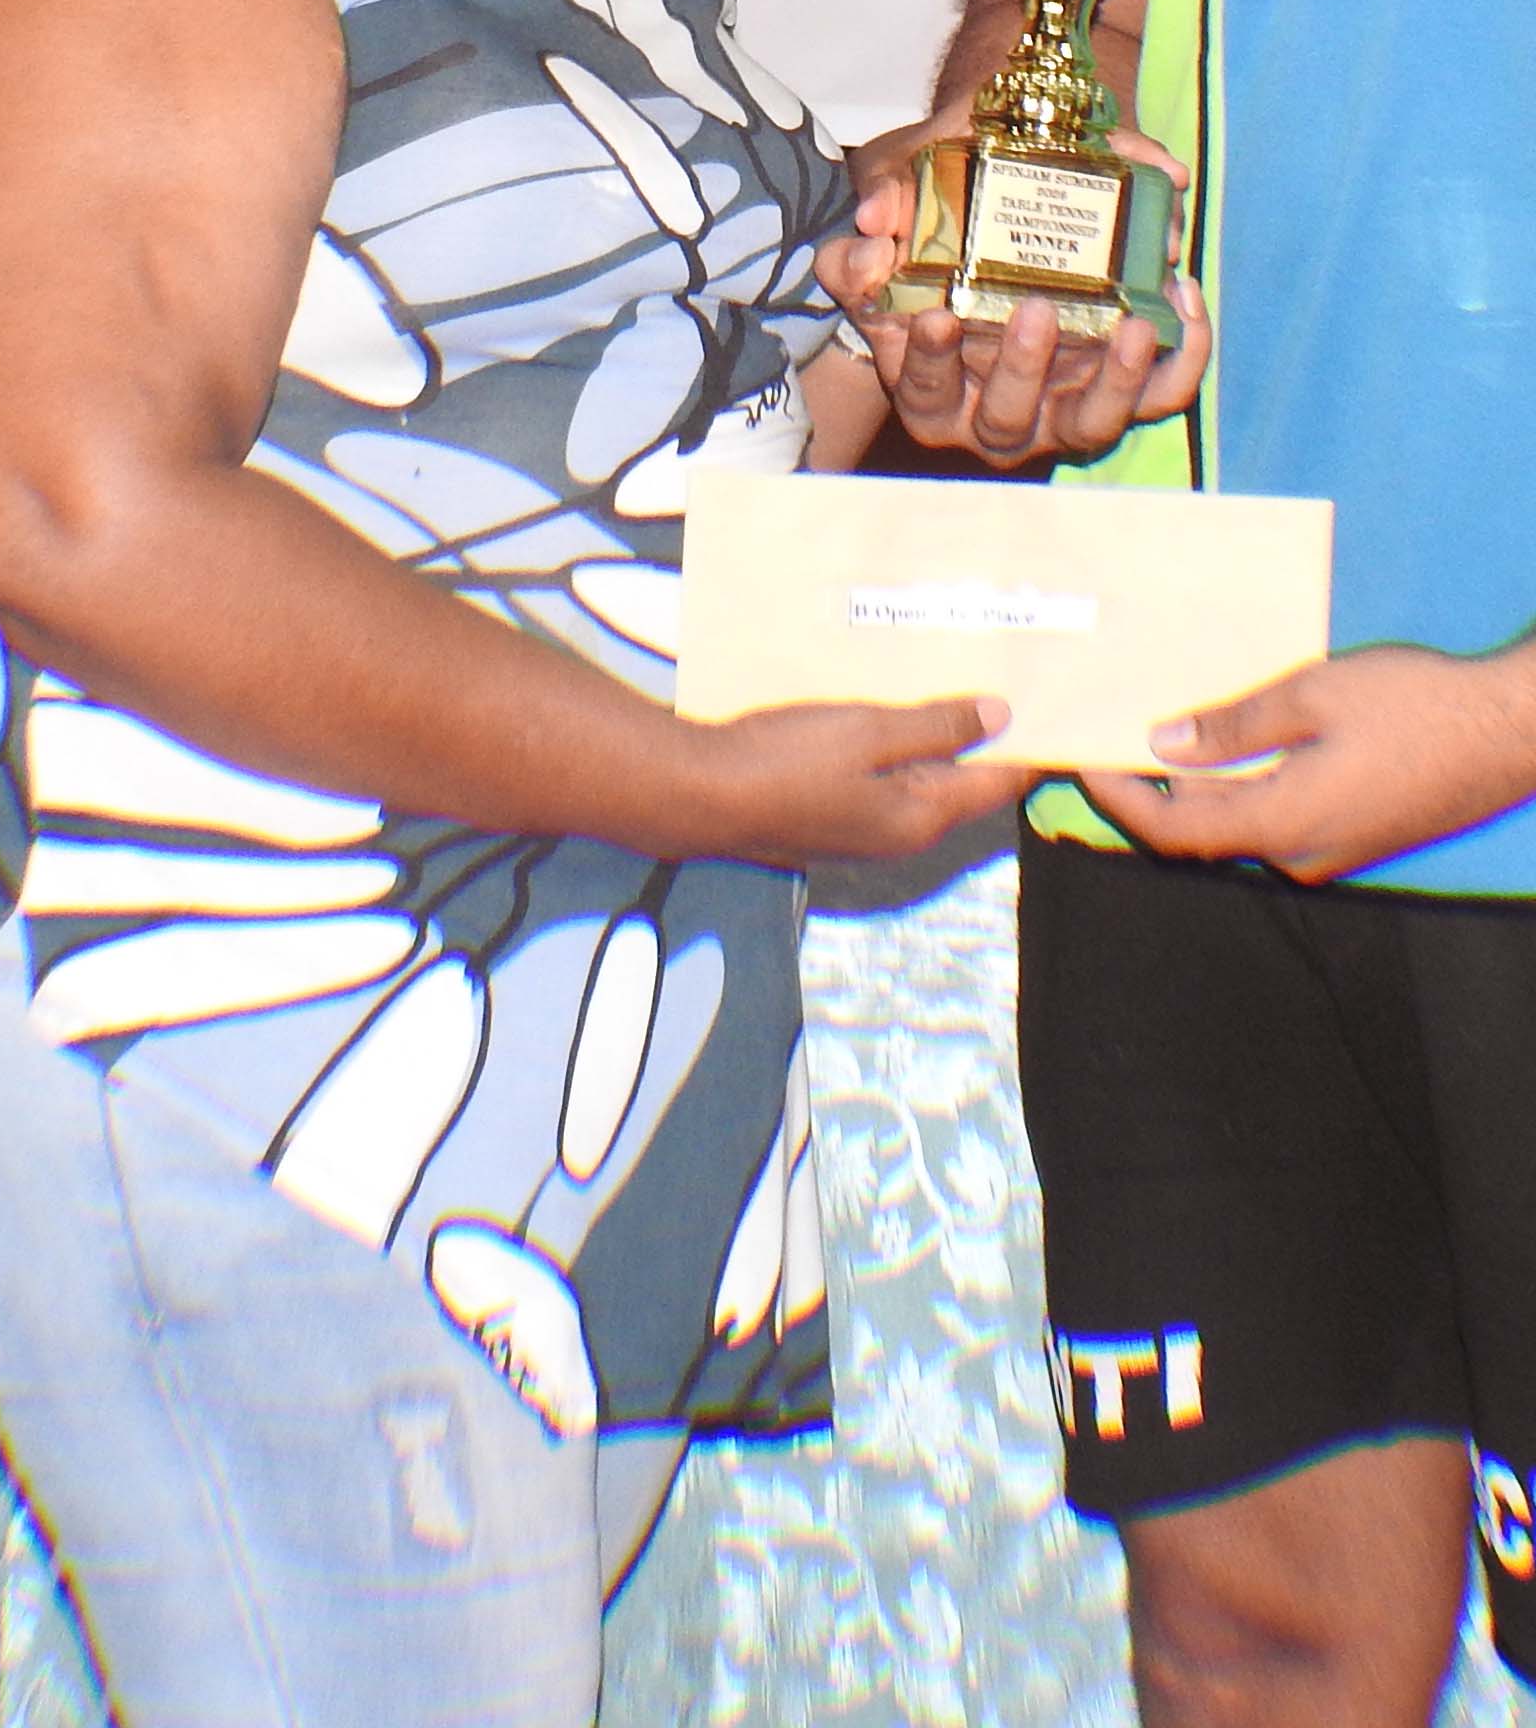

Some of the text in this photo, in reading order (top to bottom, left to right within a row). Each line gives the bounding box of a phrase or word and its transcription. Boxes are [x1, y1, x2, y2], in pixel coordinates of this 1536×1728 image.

[1047, 203, 1099, 222] TENNIS
[1009, 230, 1079, 254] WINNER
[1016, 250, 1052, 267] MEN
[1046, 1322, 1204, 1441] TI
